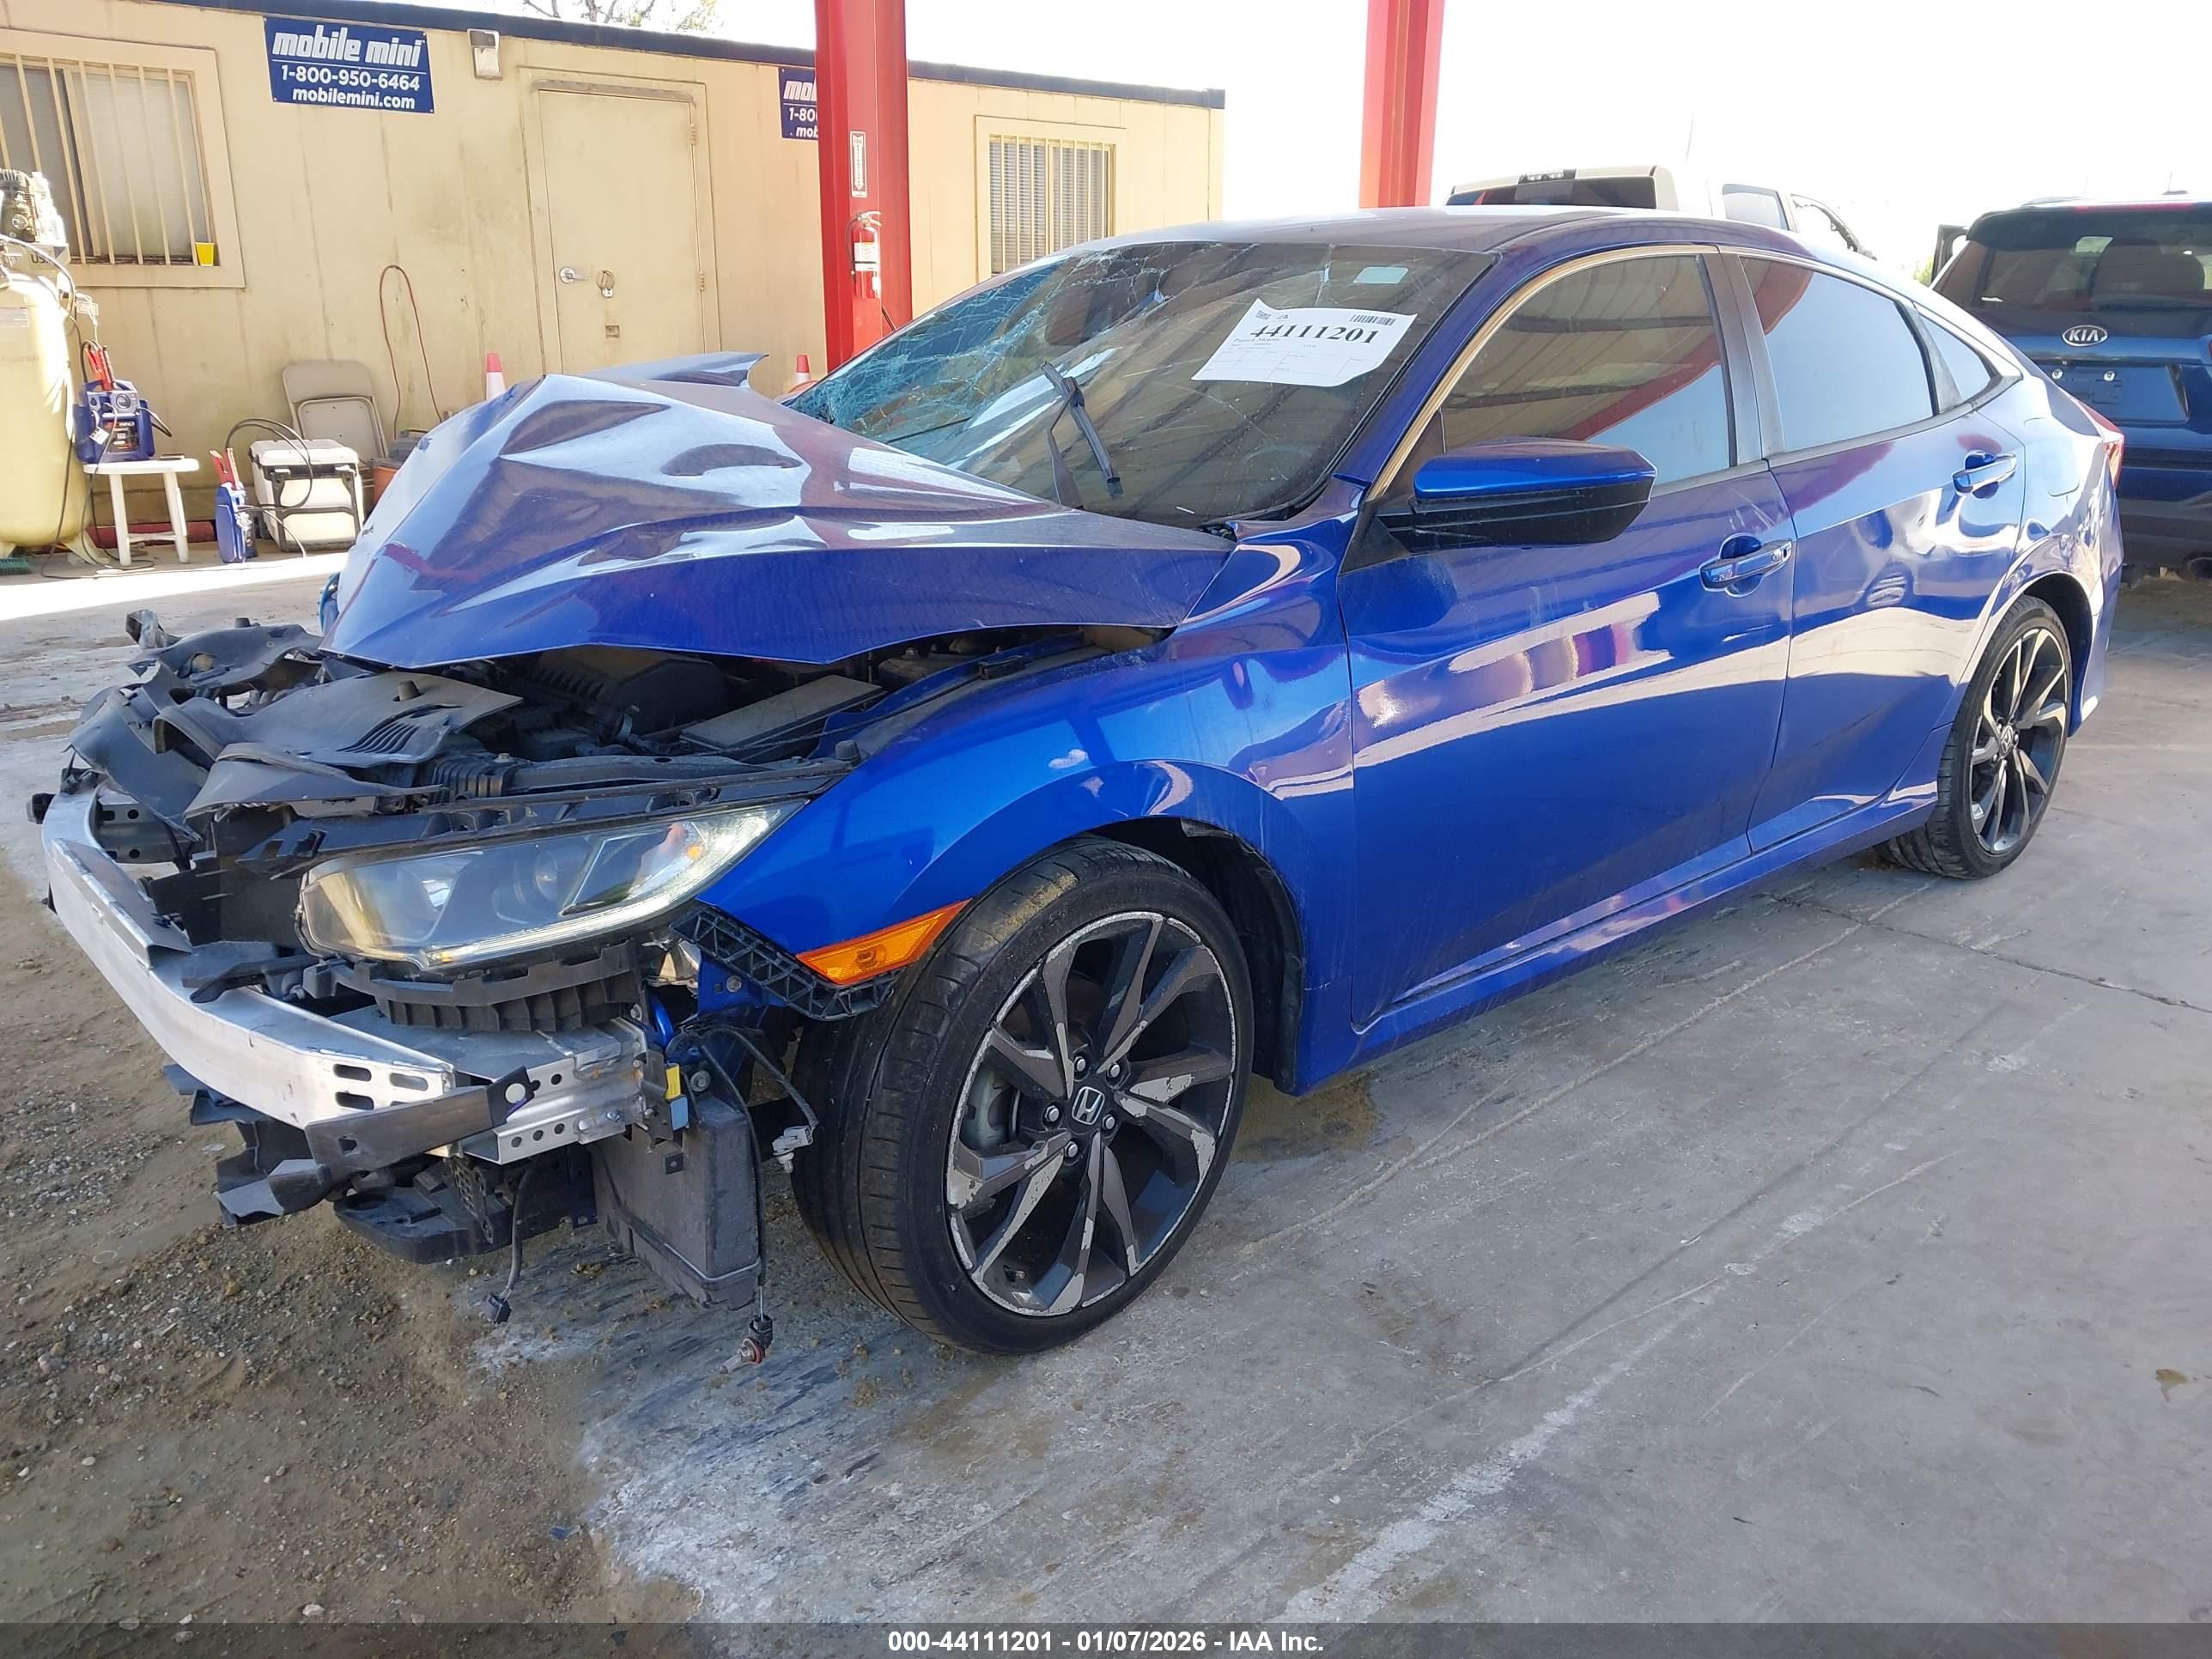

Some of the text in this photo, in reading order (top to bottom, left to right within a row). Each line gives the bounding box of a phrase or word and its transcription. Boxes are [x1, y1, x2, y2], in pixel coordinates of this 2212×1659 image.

[271, 24, 422, 67] mobile mini
[281, 64, 420, 91] 1-800-950-6464
[292, 87, 416, 110] mobilemini.com
[1250, 325, 1379, 343] 44111201
[2069, 329, 2099, 342] KIA
